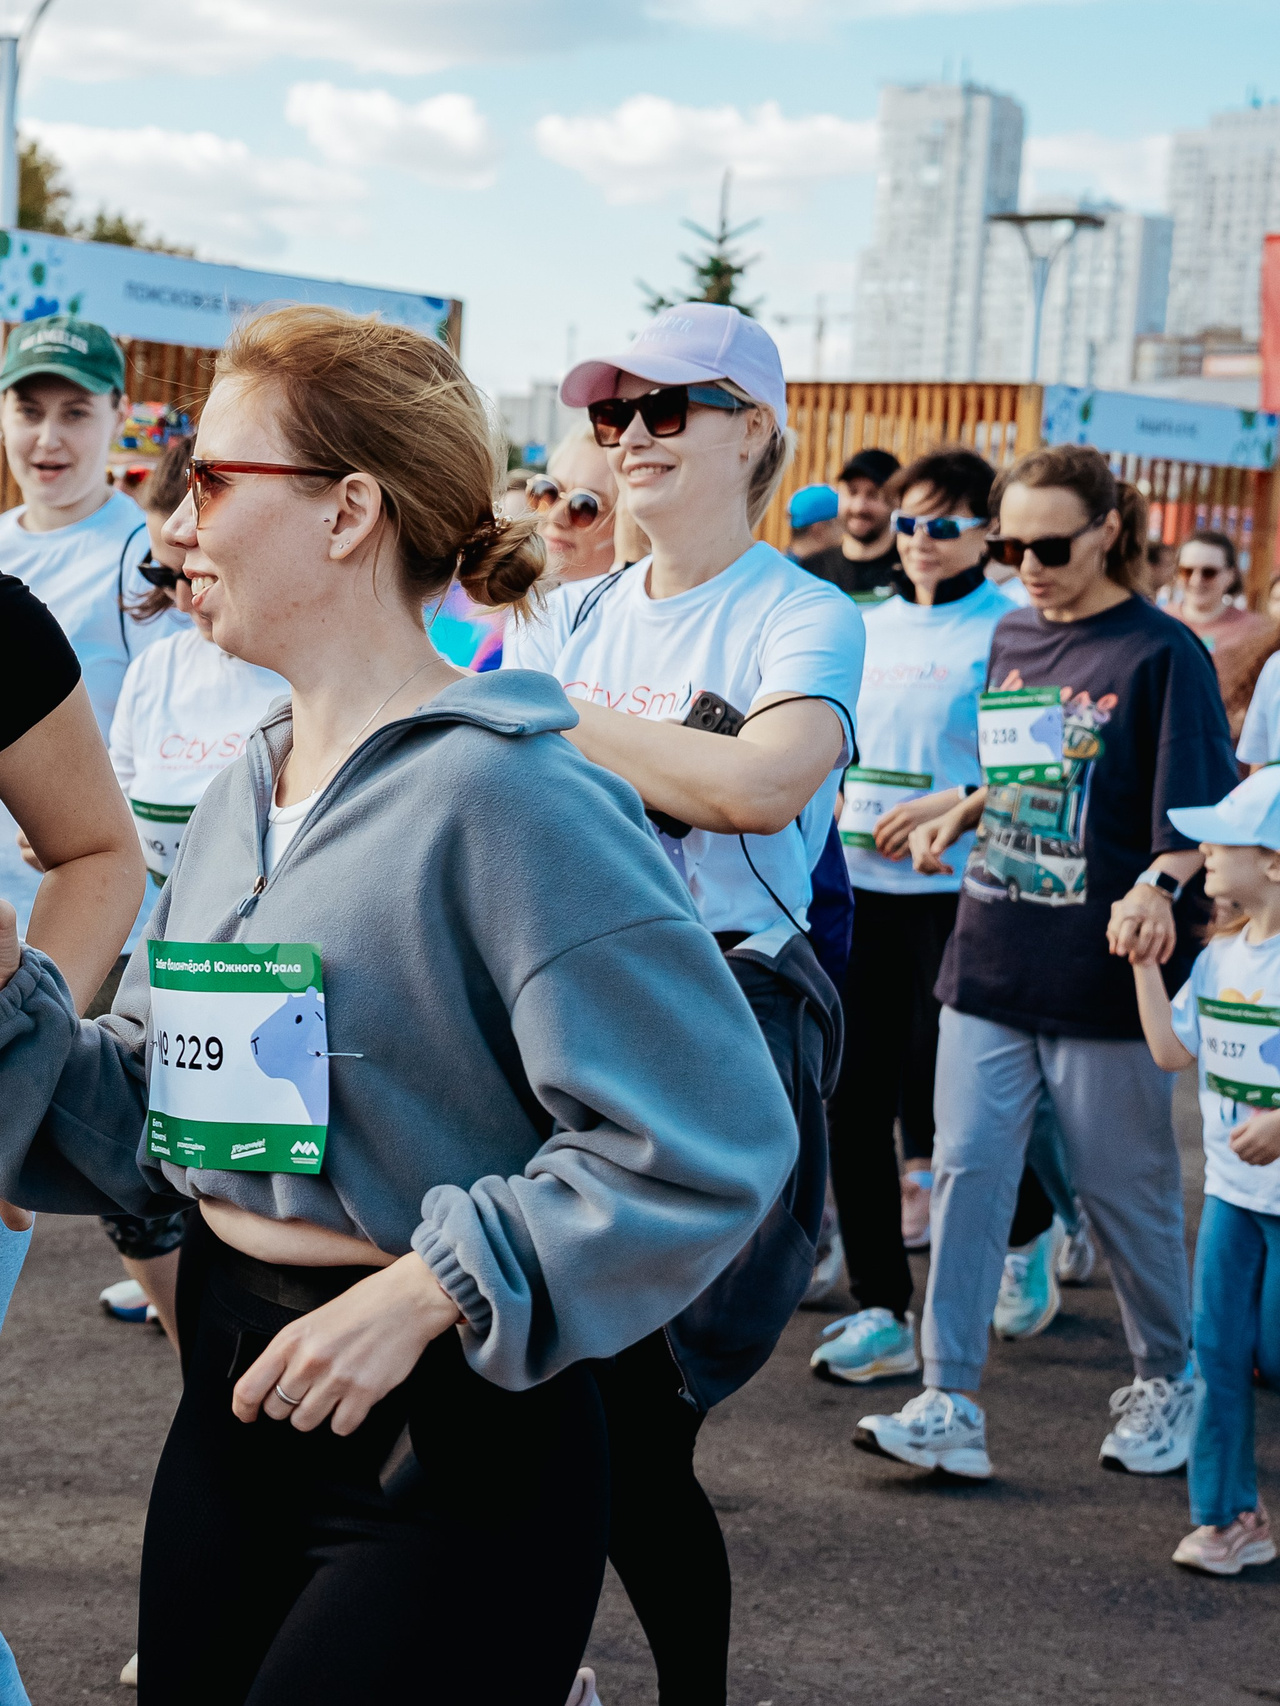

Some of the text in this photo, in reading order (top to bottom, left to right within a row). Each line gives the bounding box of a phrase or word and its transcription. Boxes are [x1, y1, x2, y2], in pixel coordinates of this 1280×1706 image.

[213, 960, 261, 974] Южного
[263, 961, 302, 975] Урала
[175, 1034, 224, 1071] 229
